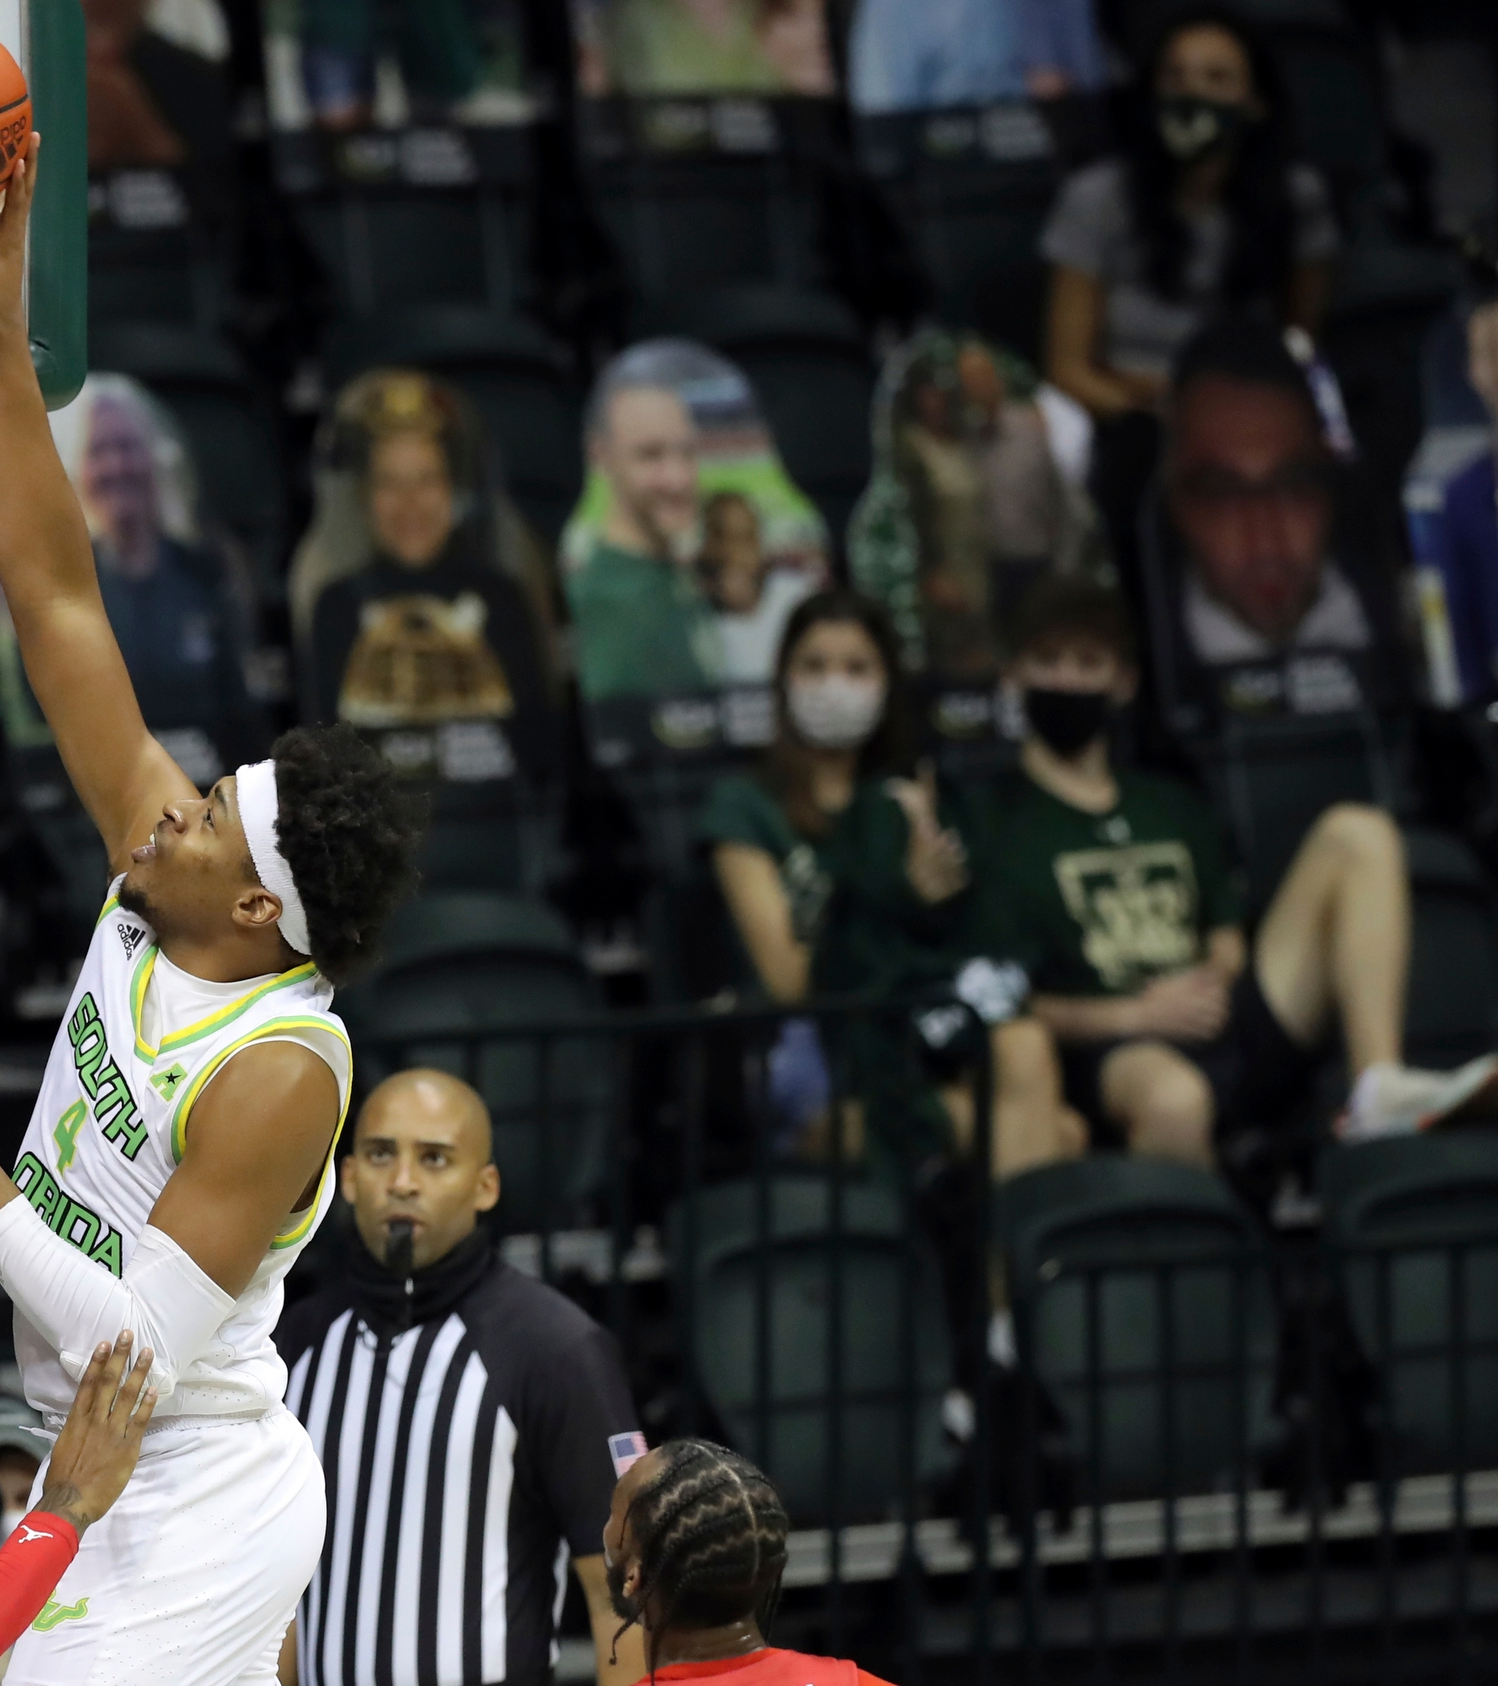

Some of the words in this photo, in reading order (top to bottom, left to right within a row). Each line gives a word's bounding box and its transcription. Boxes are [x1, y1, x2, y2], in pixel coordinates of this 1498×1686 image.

[117, 923, 133, 961] adidas
[68, 991, 149, 1162] SOUTH
[54, 1097, 89, 1177] 4
